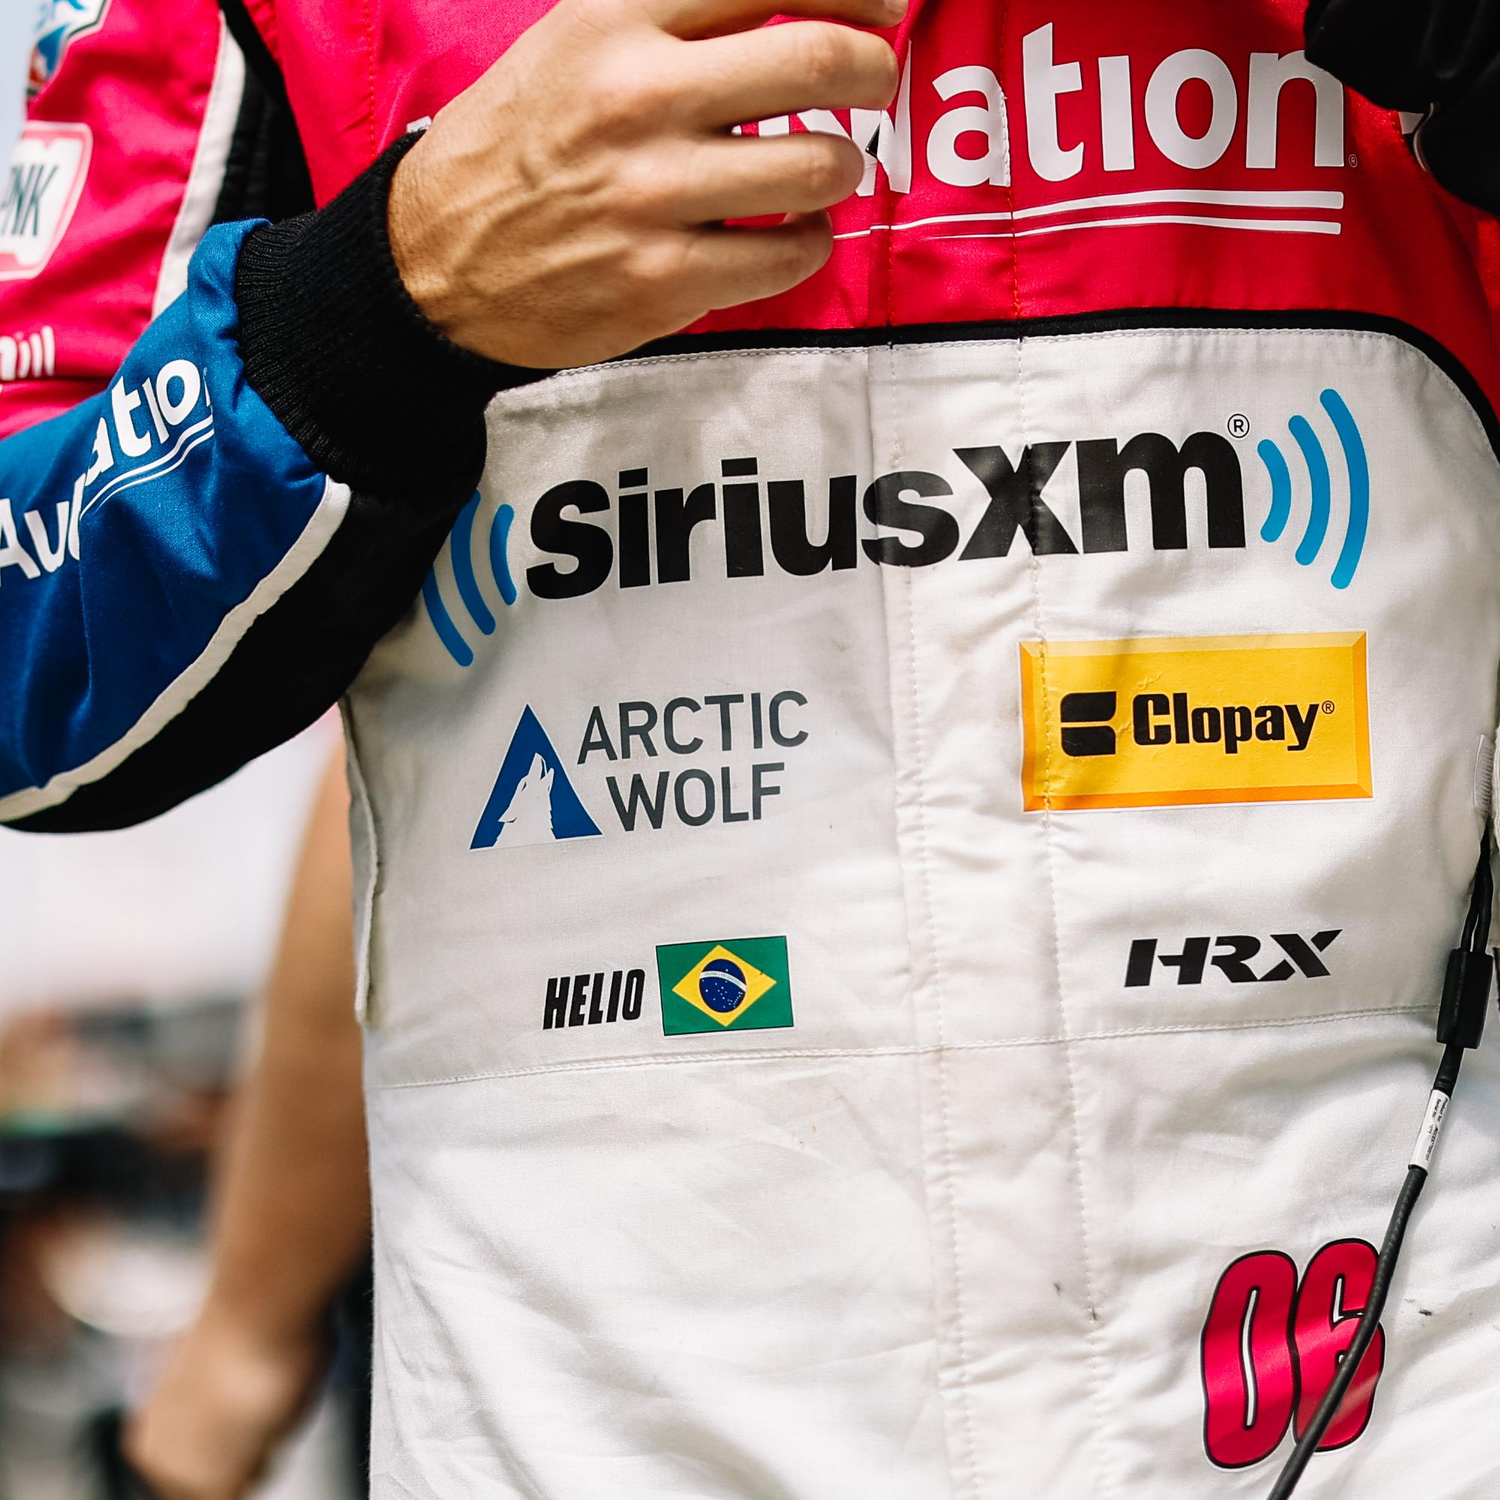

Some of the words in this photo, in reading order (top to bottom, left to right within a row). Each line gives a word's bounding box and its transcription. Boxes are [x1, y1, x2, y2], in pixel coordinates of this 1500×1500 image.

[577, 689, 810, 765] ARCTIC
[1133, 692, 1317, 754] Clopay
[605, 761, 785, 833] WOLF
[1125, 929, 1343, 988] HRX
[543, 968, 645, 1031] HELIO
[1200, 1237, 1386, 1469] 06
